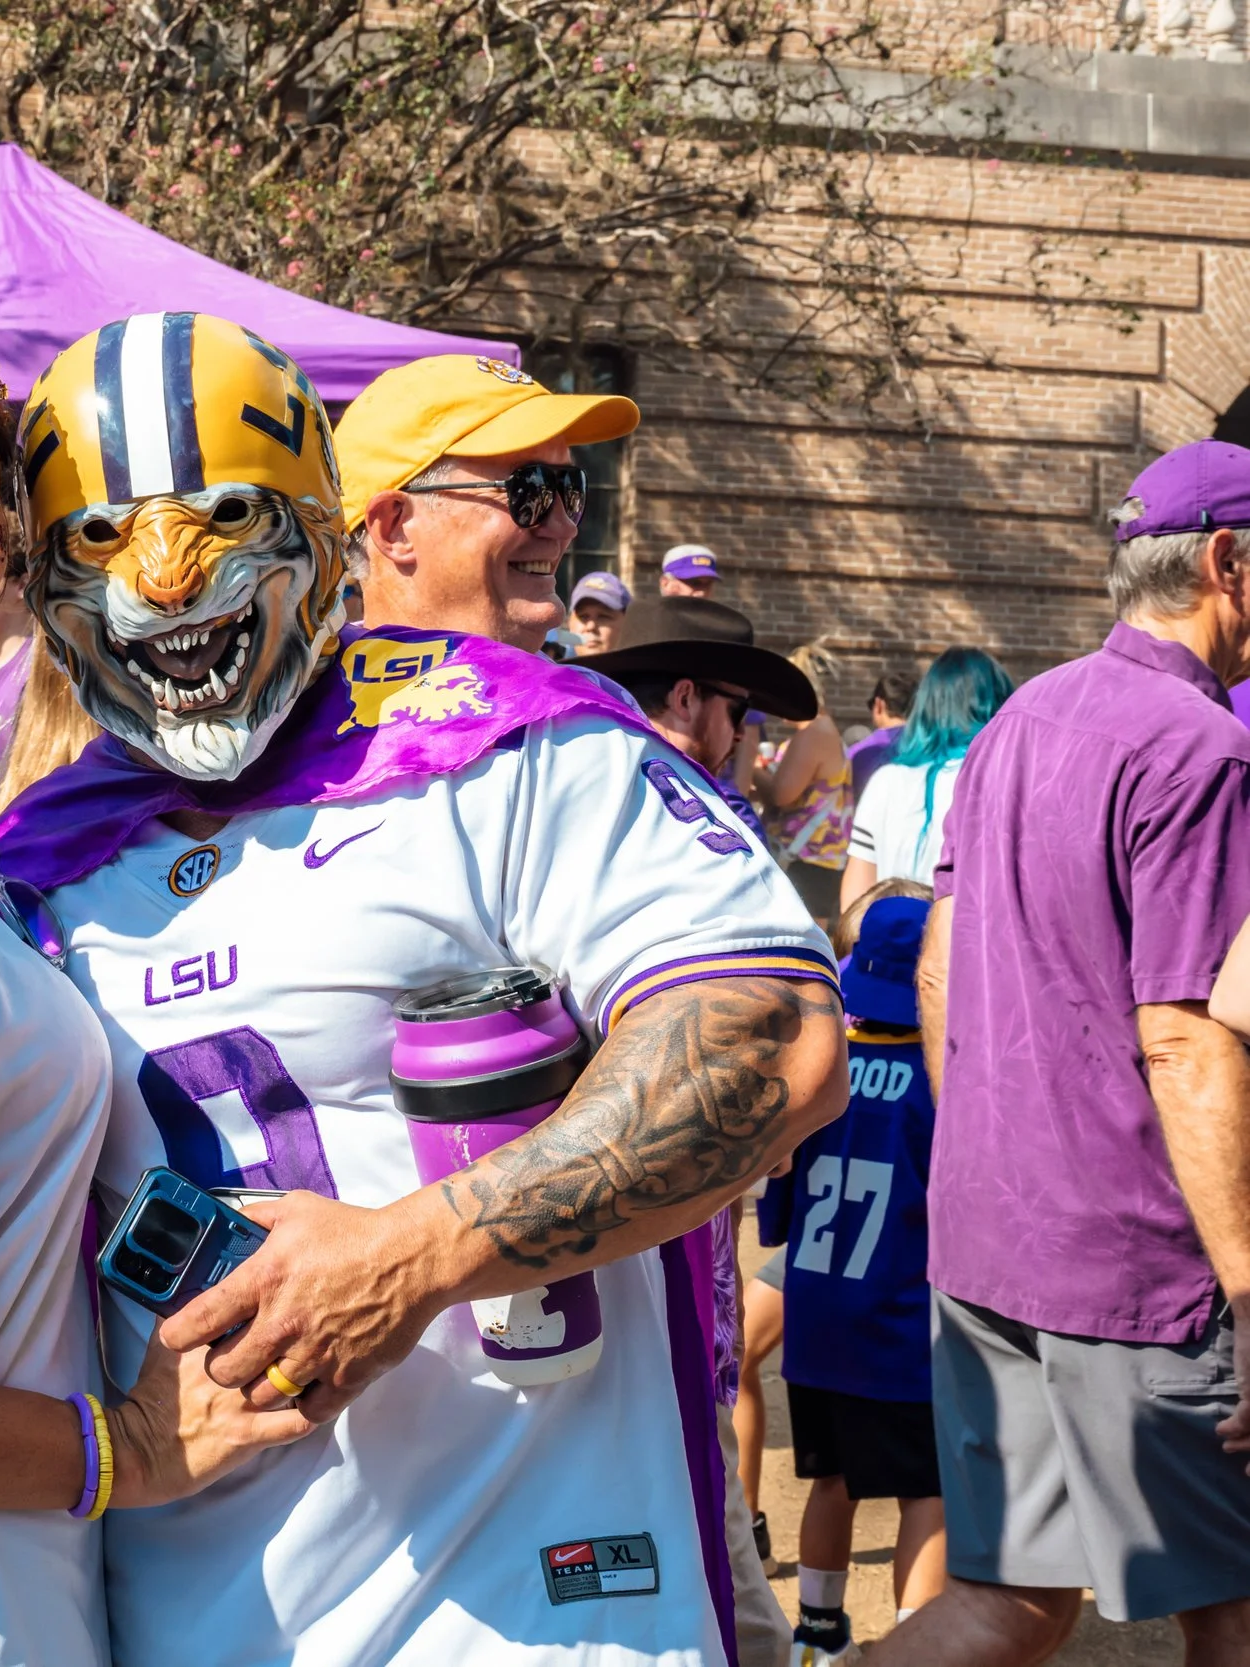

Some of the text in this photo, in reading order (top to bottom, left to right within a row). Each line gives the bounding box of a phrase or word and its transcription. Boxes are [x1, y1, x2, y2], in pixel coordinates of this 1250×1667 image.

[641, 758, 754, 857] 9
[177, 851, 215, 892] SEC
[144, 944, 238, 1006] LSU
[793, 1155, 894, 1280] 27
[556, 1564, 594, 1575] TEAM
[607, 1544, 641, 1565] XL
